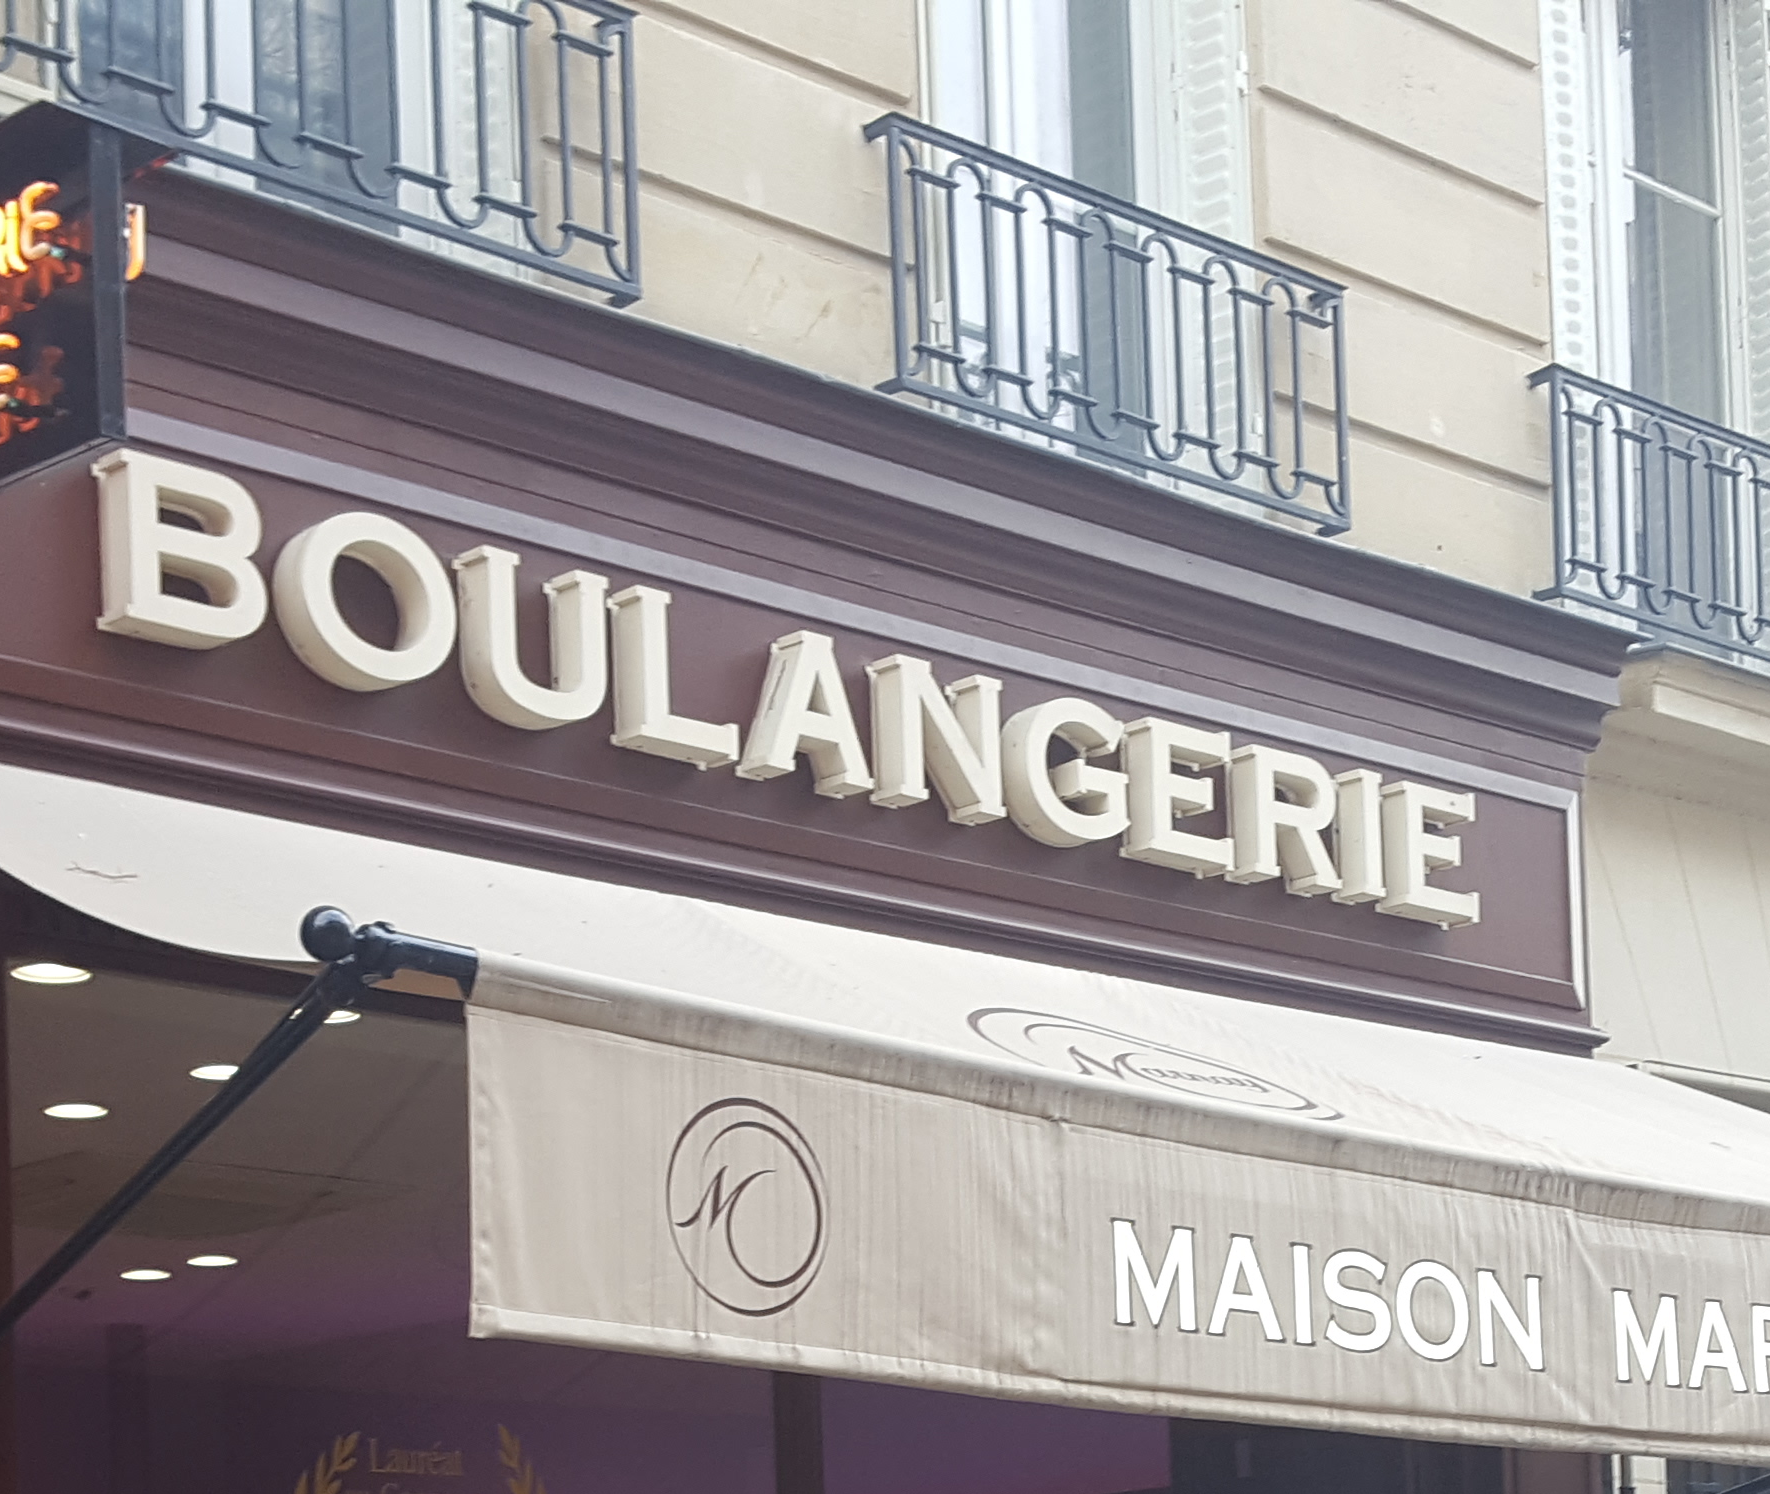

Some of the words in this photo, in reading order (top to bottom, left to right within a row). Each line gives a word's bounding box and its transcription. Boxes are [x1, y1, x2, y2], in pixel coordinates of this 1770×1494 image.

[90, 448, 1485, 930] BOULANGERIE
[1066, 1043, 1271, 1095] Marnay
[1109, 1216, 1547, 1375] MAISON
[368, 1436, 464, 1476] Lauréat
